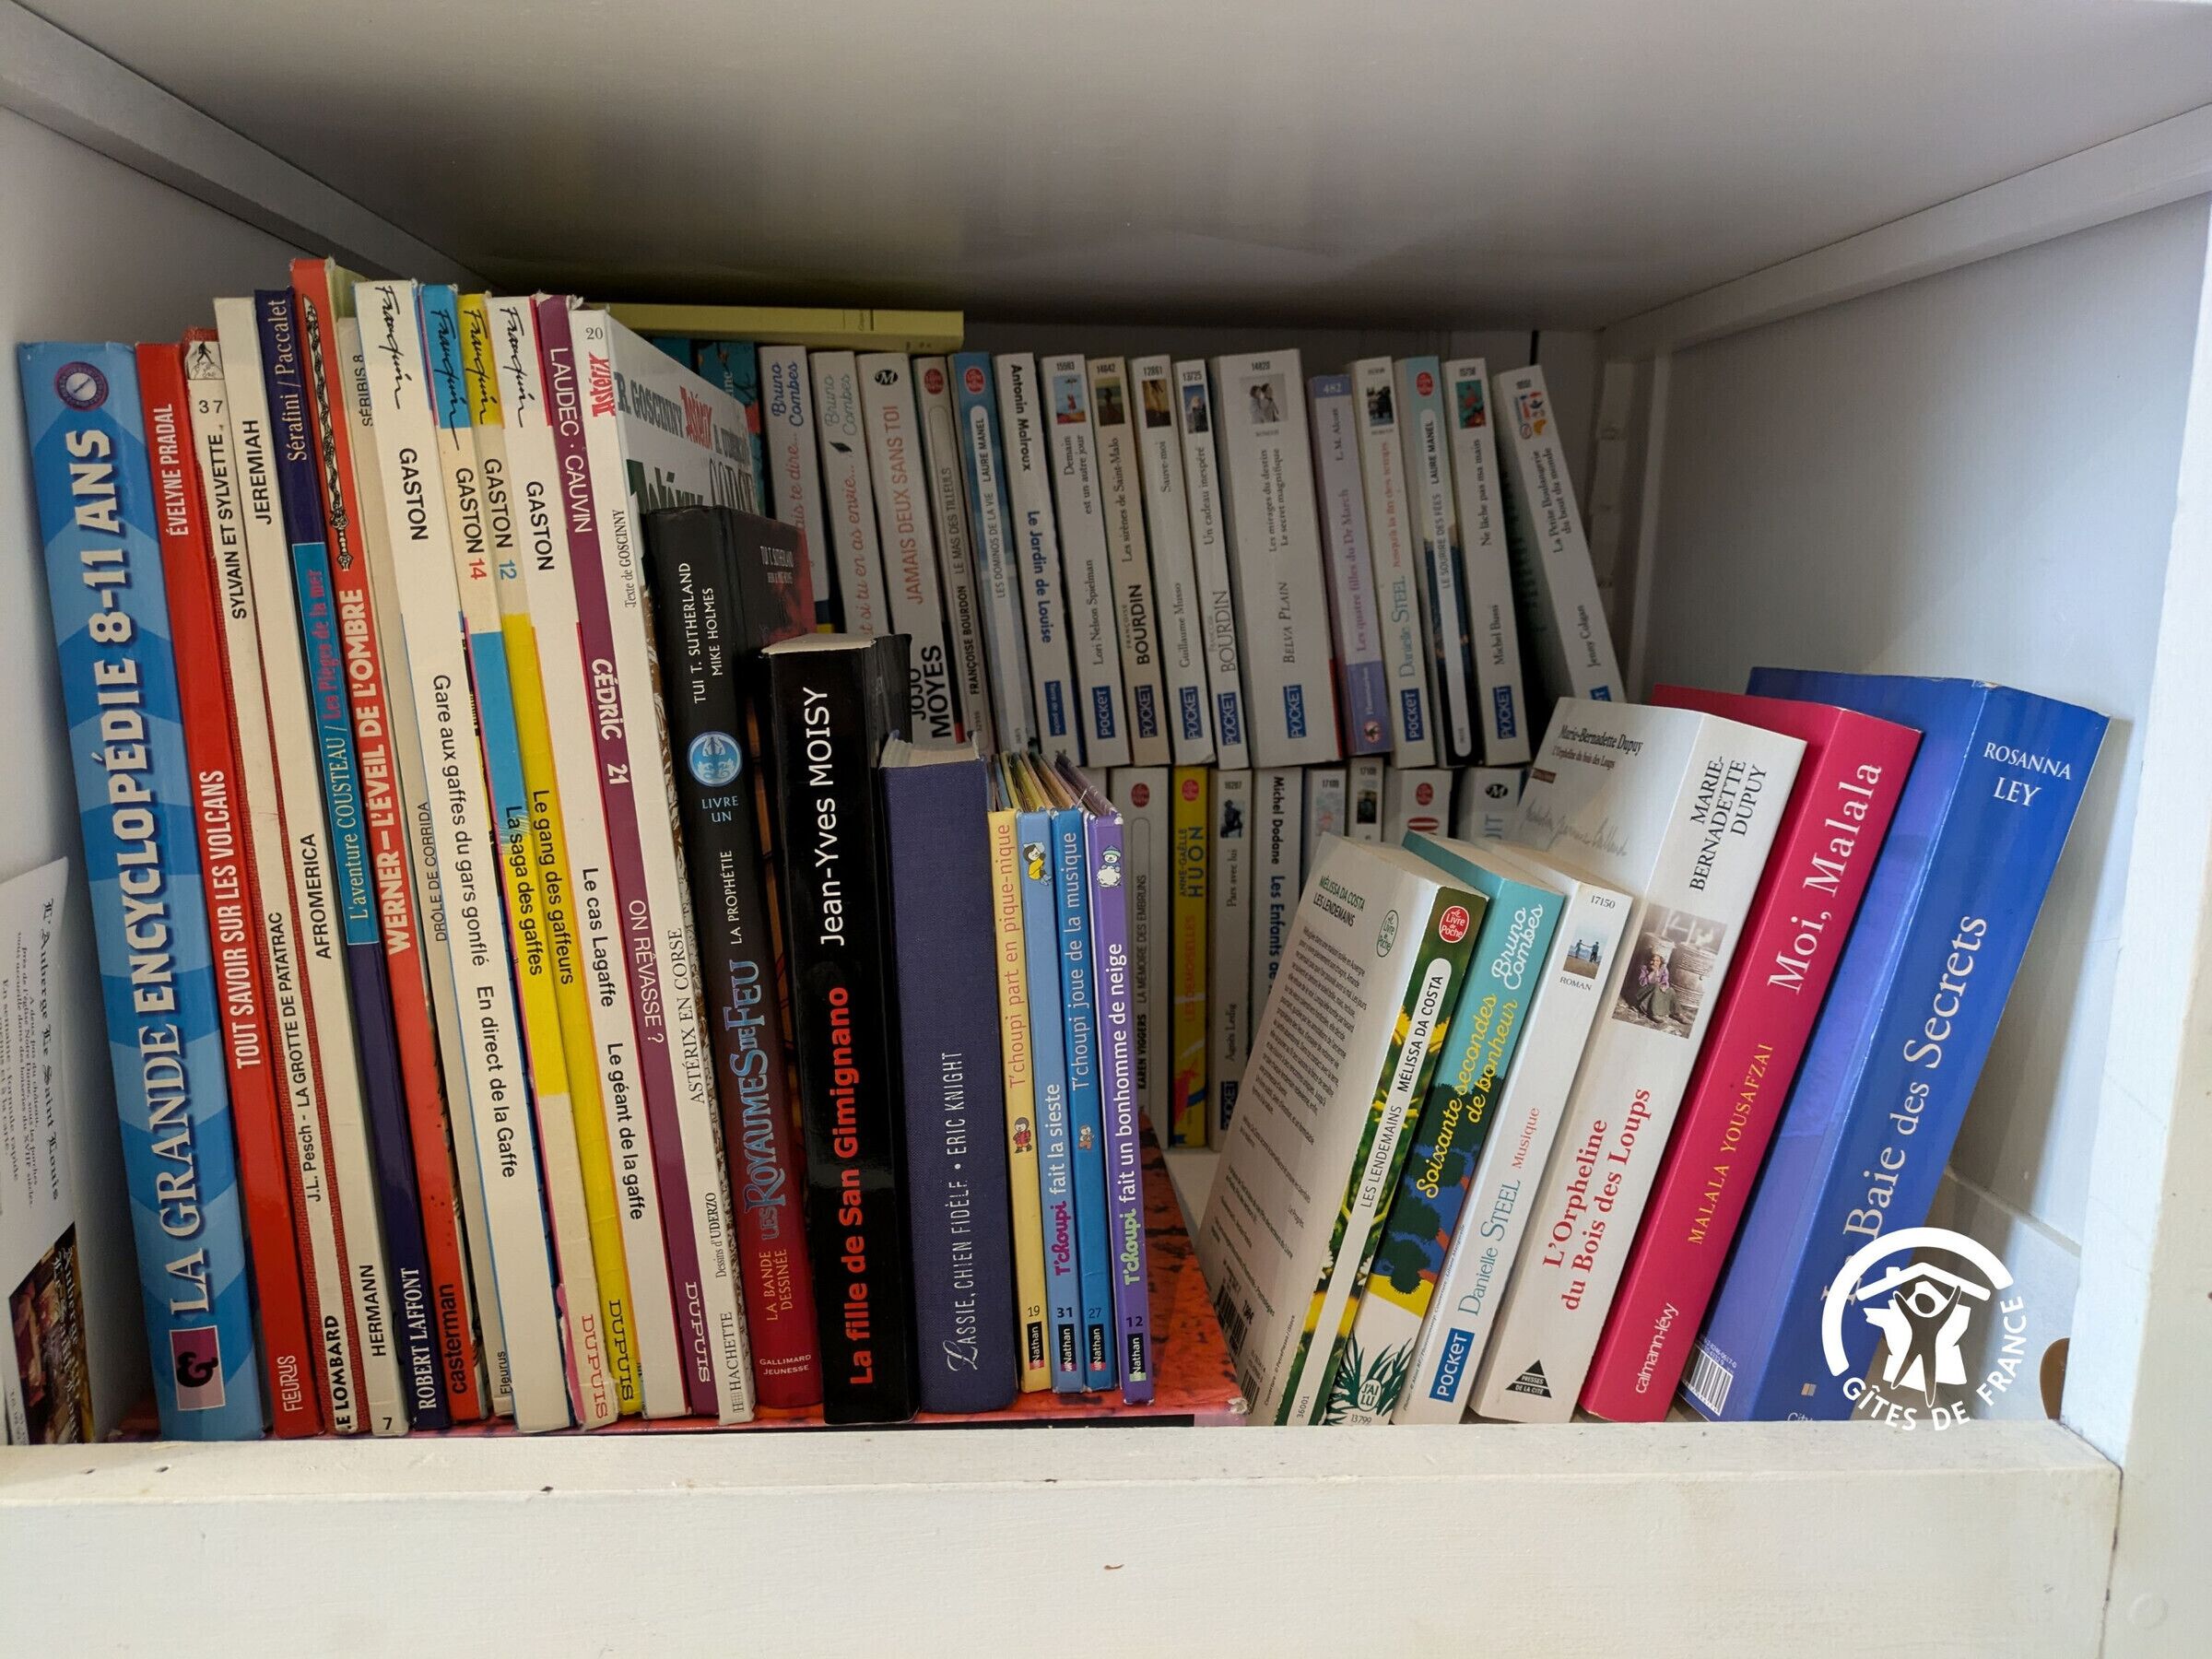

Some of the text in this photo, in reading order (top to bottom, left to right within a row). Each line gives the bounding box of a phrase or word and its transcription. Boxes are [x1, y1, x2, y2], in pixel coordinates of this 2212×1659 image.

[585, 326, 605, 341] 20
[771, 362, 787, 418] Bruno
[789, 361, 805, 427] Combes
[1011, 364, 1031, 471] Antonin Malroux
[154, 404, 189, 535] ÉVELYNE PRADAL
[242, 420, 272, 524] JEREMIAH
[550, 347, 593, 533] LAUDEC CAUVIN
[399, 448, 429, 540] GASTON
[455, 468, 487, 580] GASTON 14
[882, 406, 924, 605] JAMAIS DEUX SANS TOI
[612, 510, 637, 607] Texte de GOSCINNY
[1027, 511, 1053, 643] Le Jardin de Louise
[678, 562, 706, 704] TUI T. SUTHERLAND
[702, 588, 723, 676] MIKE HOLMES
[958, 586, 980, 695] FRANÇOISE BOURDON
[1129, 584, 1151, 666] BOURDIN
[1214, 591, 1237, 674] BOURDIN
[590, 656, 629, 784] CÉDRIC 21
[921, 645, 952, 738] MOYES
[701, 795, 740, 810] LIVRE
[1689, 756, 1725, 826] MARIE-
[1729, 764, 1768, 838] DUPUY
[1984, 742, 2073, 782] ROSANNA
[1994, 777, 2041, 807] LEY
[712, 811, 733, 824] UN
[803, 687, 845, 947] Jean-Yves MOISY
[1271, 776, 1285, 865] Michel Dodane
[1688, 759, 1747, 893] BERNADETTE
[65, 429, 209, 1314] LA GRANDE ENCYCLOPÉDIE 8-11 ANS
[300, 833, 332, 959] AFROMERICA
[418, 802, 448, 941] DRÔLE DE CORRIDA
[720, 851, 742, 945] LA PROPHÉTIE
[1590, 895, 1617, 911] 17150
[1767, 765, 1882, 993] Moi, Malala
[199, 768, 261, 1069] TOUT SAVOIR SUR LES VOLCANS
[998, 824, 1029, 1090] T'choupi part en pique-nique
[1491, 908, 1526, 979] Bruno
[1503, 903, 1546, 991] Combes
[667, 930, 705, 1103] ASTÉRIX EN CORSE
[1559, 976, 1594, 993] ROMAN
[1397, 977, 1443, 1092] MÉLISSA DA COSTA
[1465, 998, 1518, 1124] de bonheur
[1843, 916, 1986, 1240] Baie des Secrets
[941, 1053, 964, 1111] KNIGHT
[1416, 1096, 1465, 1200] Soixante
[1455, 993, 1499, 1097] secondes
[946, 1119, 967, 1155] ERIC
[1360, 1106, 1402, 1207] LES LENDEMAINS
[1688, 1044, 1773, 1244] MALALA YOUSAFZAI
[829, 987, 873, 1383] La fille de San Gimignano
[1457, 1108, 1539, 1316] Danielle STEEL Musique
[1542, 1120, 1607, 1268] L'Orpheline
[1561, 1089, 1652, 1311] du Bois des Loups
[705, 1193, 727, 1278] Dessins d'UDERZO
[952, 1241, 974, 1288] CHIEN
[359, 1265, 386, 1357] HERMANN
[401, 1268, 436, 1409] ROBERT LAFFONT
[439, 1285, 466, 1394] casterman
[720, 1312, 742, 1391] HACHETTE
[945, 1293, 978, 1371] LASSIE,
[1056, 1307, 1074, 1319] 31
[1064, 1328, 1073, 1366] Nathan
[1126, 1316, 1144, 1328] 12
[1132, 1337, 1142, 1376] Nathan
[1636, 1301, 1680, 1395] calmann-lévy
[324, 1315, 349, 1410] LOMBARD
[759, 1354, 812, 1367] GALLIMARD
[763, 1364, 810, 1377] JEUNESSE
[1297, 1395, 1311, 1418] 36001
[1360, 1394, 1375, 1406] LU
[1361, 1383, 1380, 1396] J'AI
[1436, 1333, 1468, 1399] POCKET
